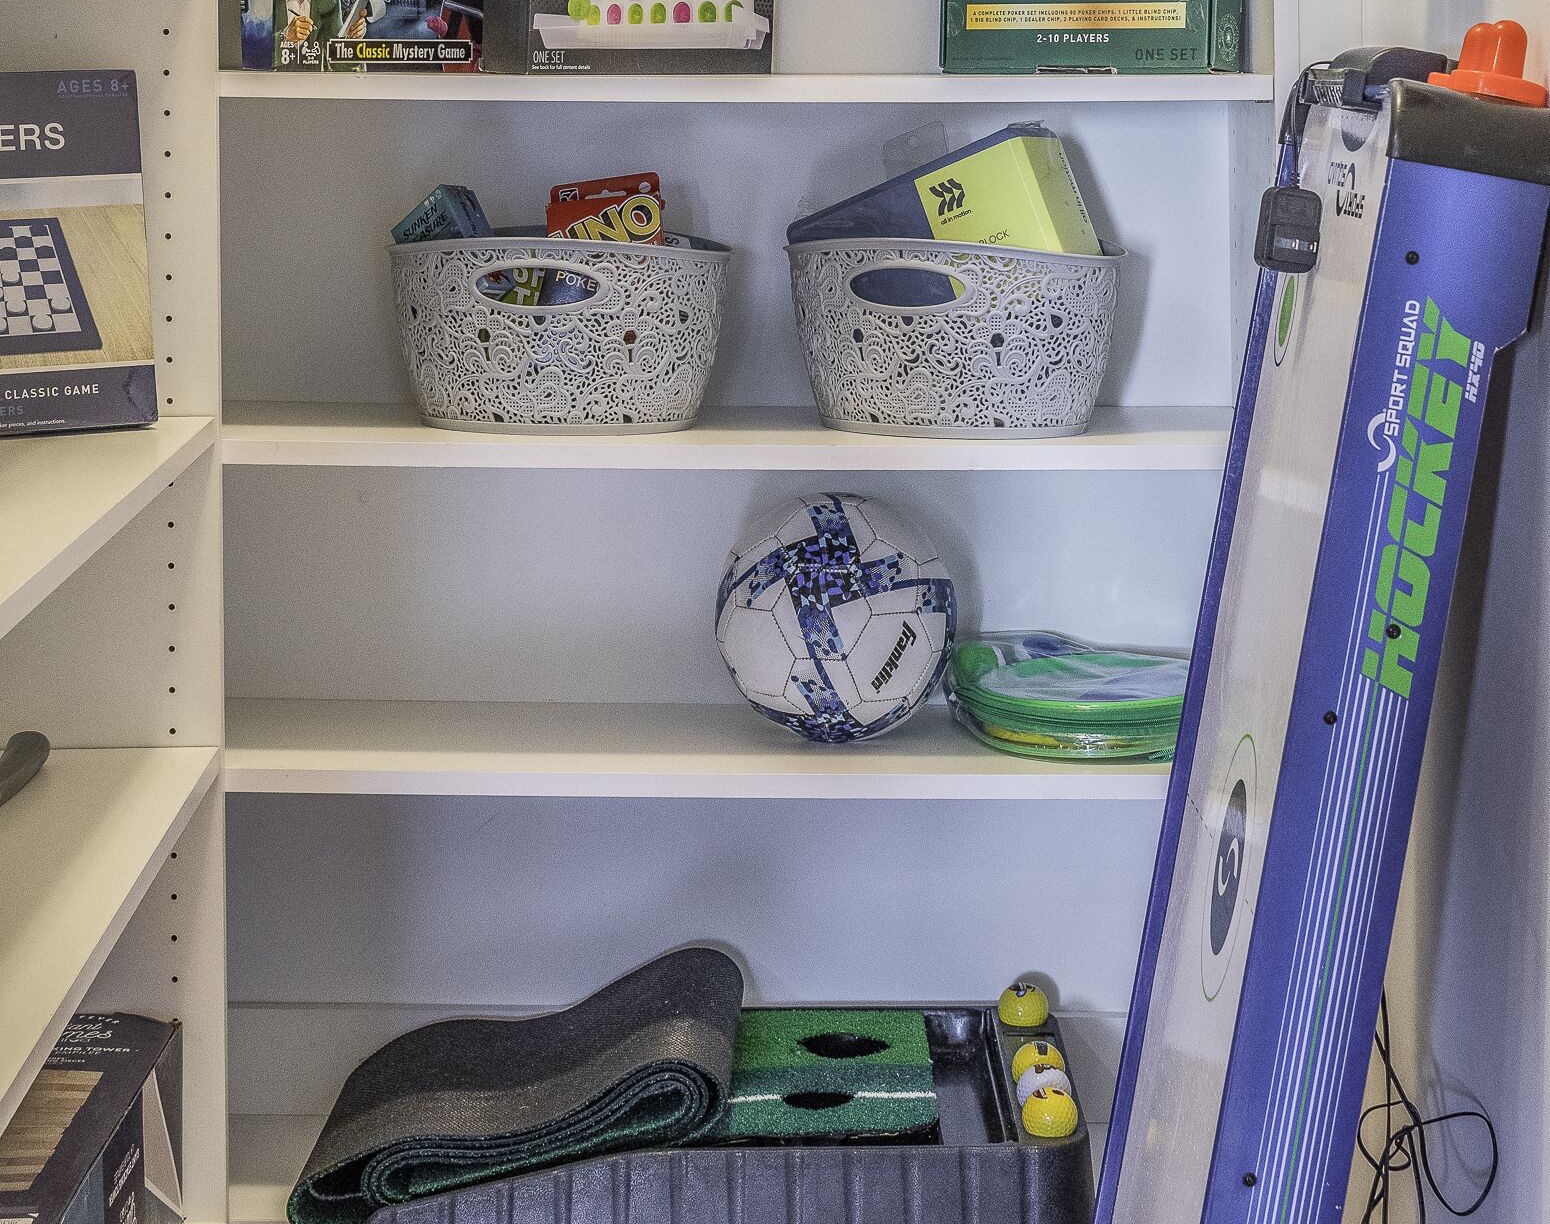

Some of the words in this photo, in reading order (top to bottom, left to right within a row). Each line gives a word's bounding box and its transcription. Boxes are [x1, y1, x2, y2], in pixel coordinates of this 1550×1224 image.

[1036, 33, 1060, 42] 2-10
[1063, 33, 1110, 42] PLAYERS
[281, 49, 296, 65] 8+
[335, 42, 354, 59] The
[356, 42, 390, 59] Classic
[392, 43, 435, 61] Mystery
[437, 44, 466, 59] Game
[533, 50, 550, 63] ONE
[550, 50, 565, 63] SET
[1134, 48, 1165, 61] ONE
[1169, 47, 1198, 60] SET
[57, 79, 102, 94] AGES
[110, 79, 129, 92] 8+
[403, 202, 438, 240] SUNKEN
[940, 218, 948, 226] all
[1394, 299, 1421, 368] SQUAD
[4, 386, 60, 400] CLASSIC
[64, 383, 100, 396] GAME
[1384, 370, 1410, 437] SPORT
[1362, 295, 1471, 700] HOCKEY
